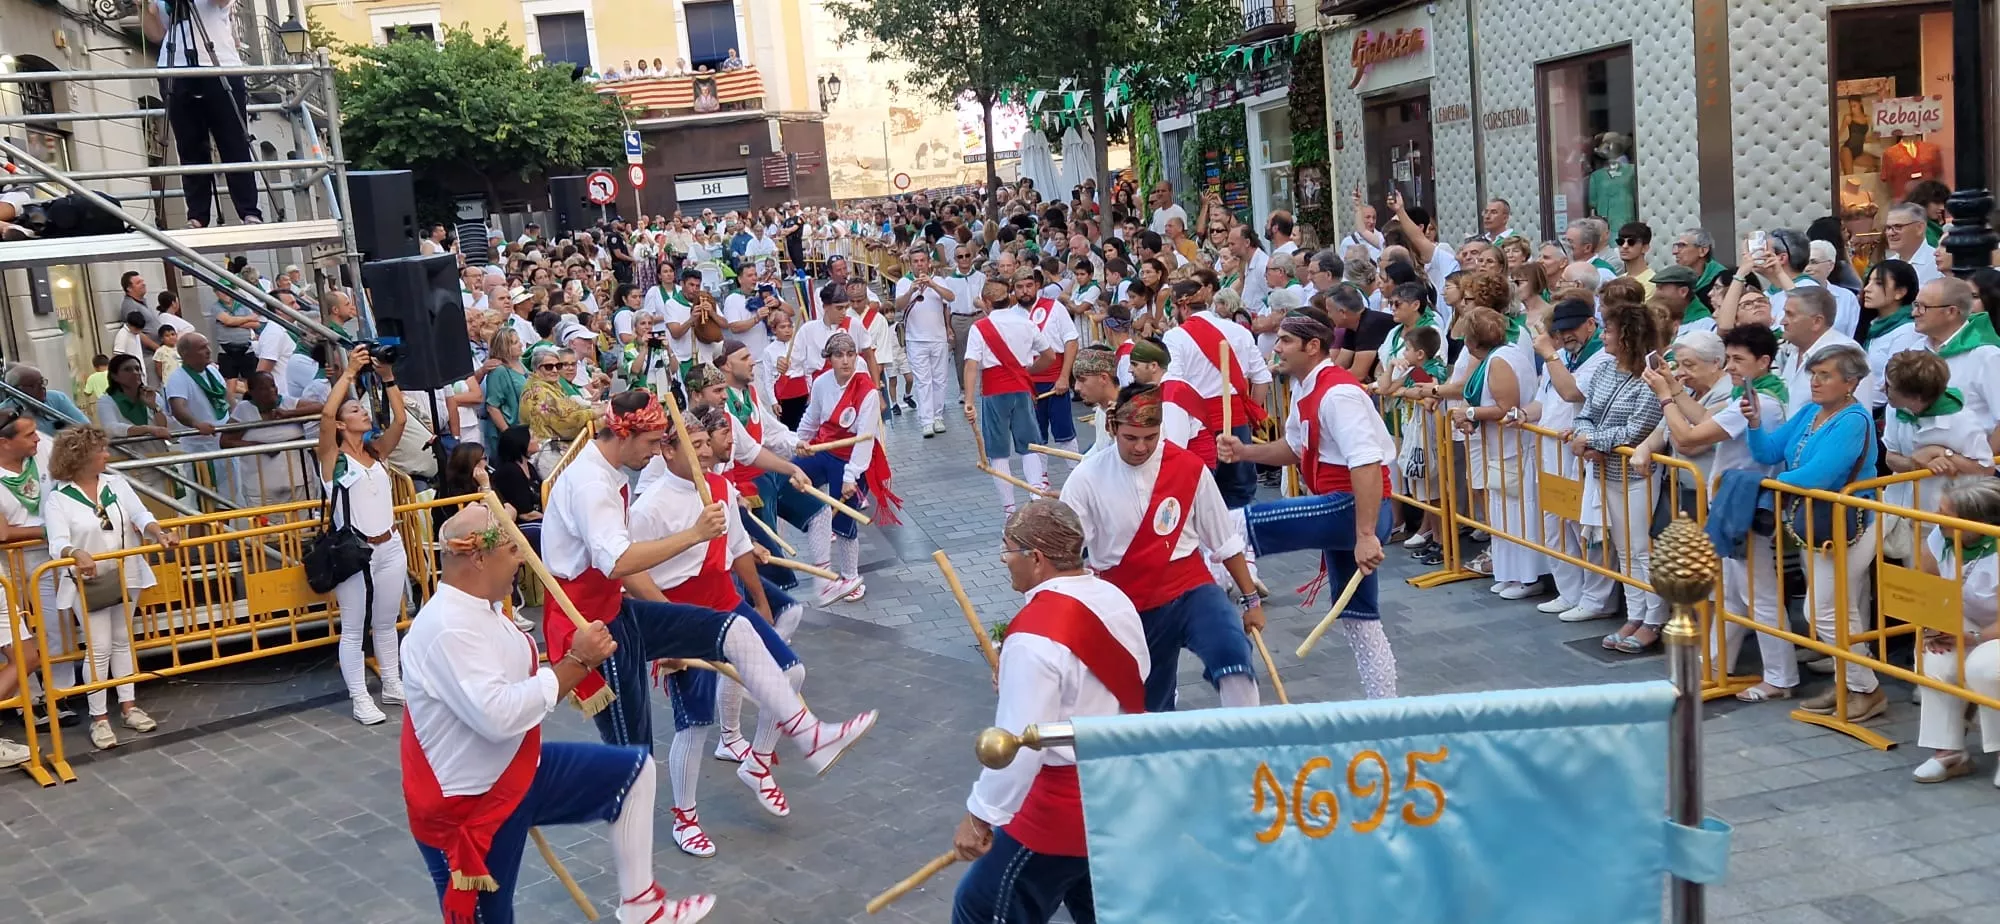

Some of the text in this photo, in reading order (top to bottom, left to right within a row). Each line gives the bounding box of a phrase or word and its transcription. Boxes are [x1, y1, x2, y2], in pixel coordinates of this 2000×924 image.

[1482, 108, 1530, 131] CORSETERIA
[1876, 105, 1940, 128] Rebajas
[1252, 746, 1448, 843] 1695
